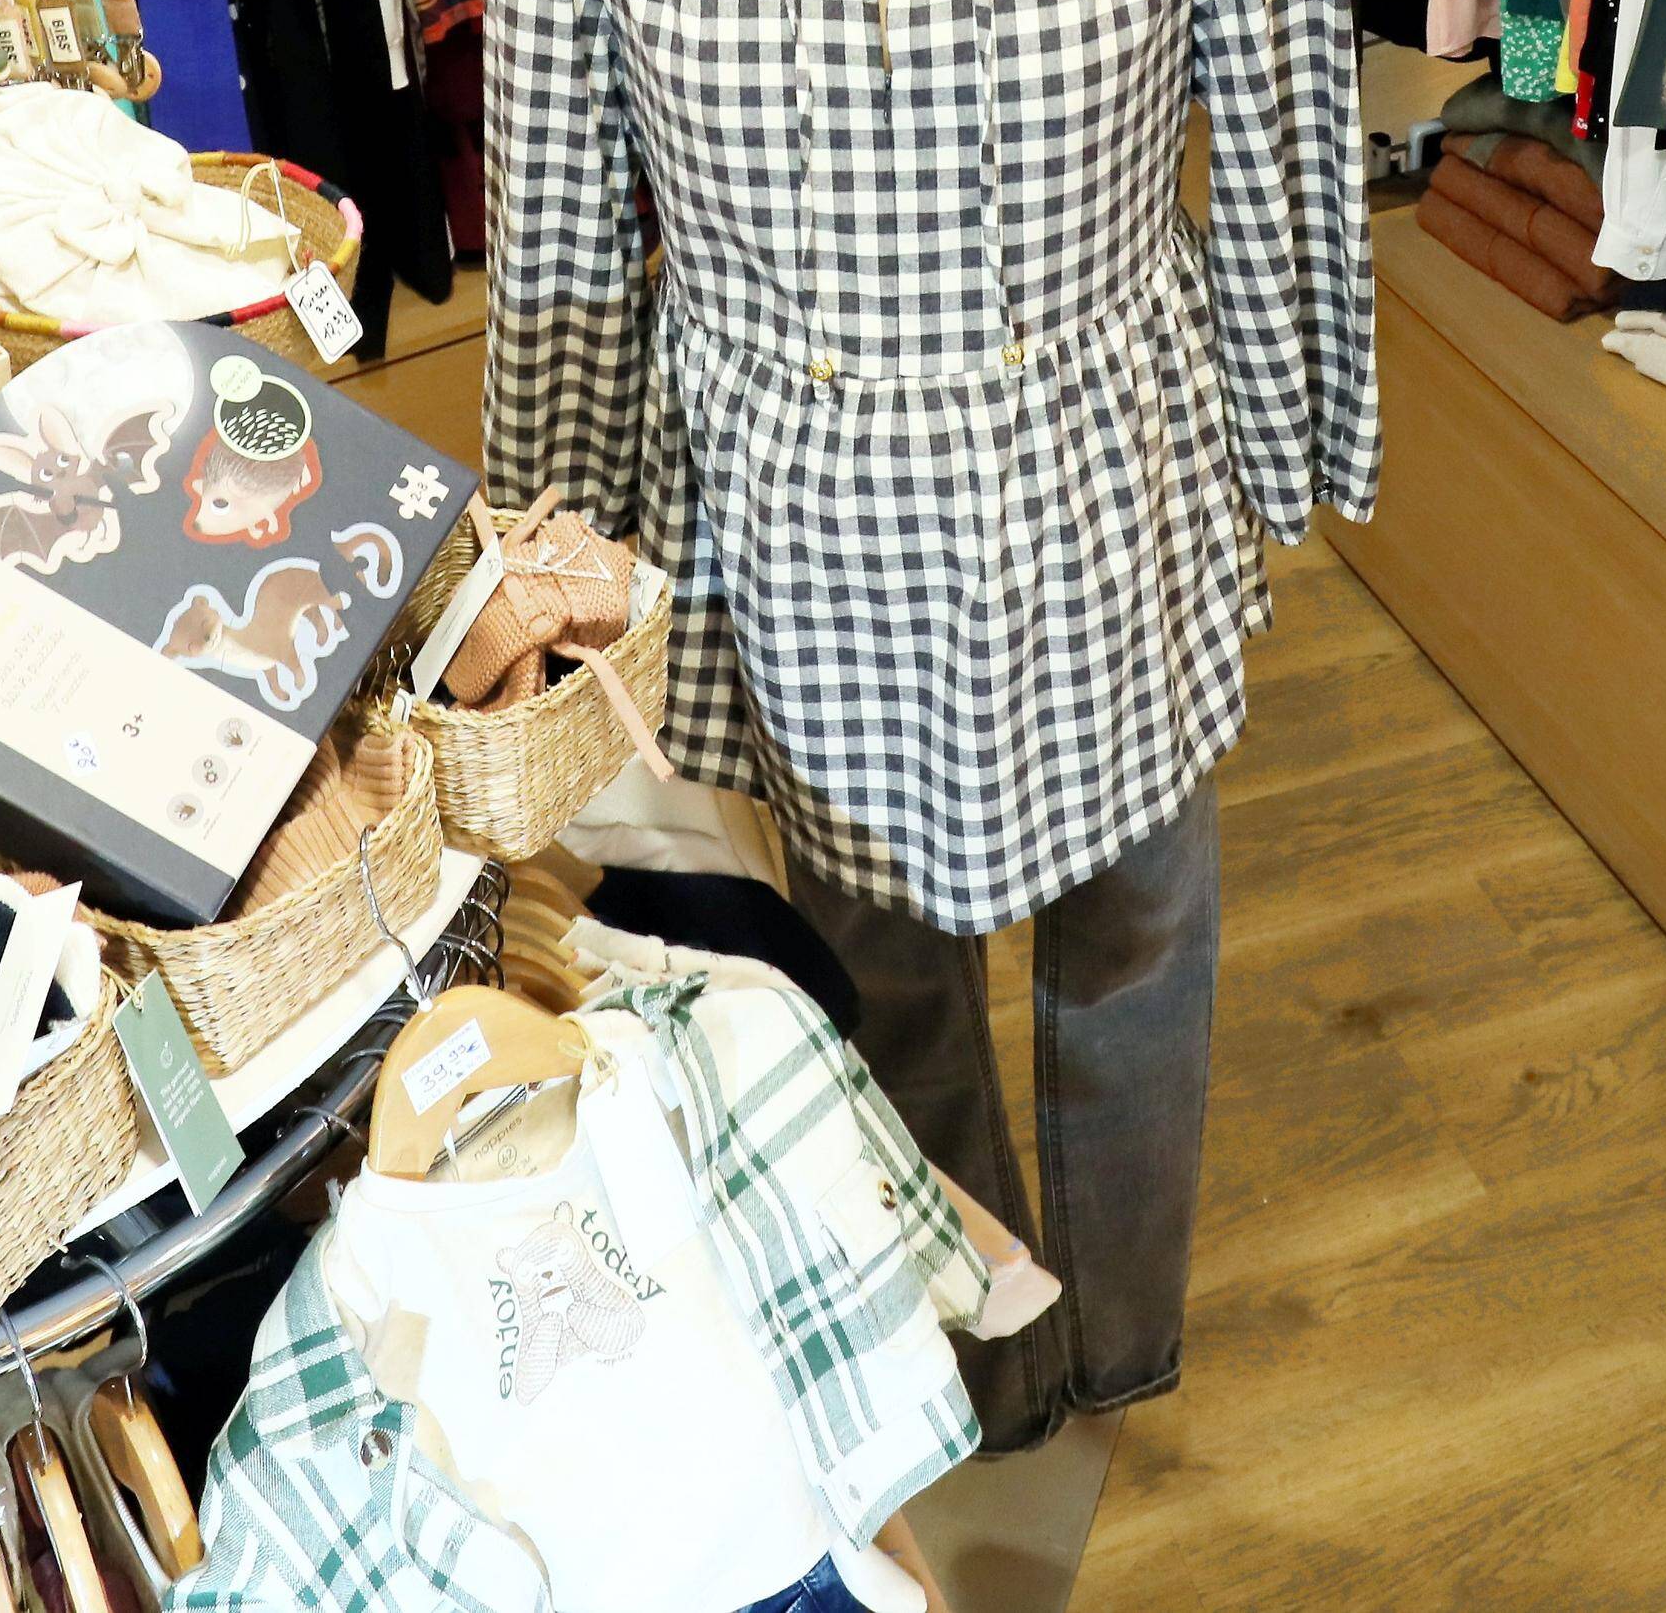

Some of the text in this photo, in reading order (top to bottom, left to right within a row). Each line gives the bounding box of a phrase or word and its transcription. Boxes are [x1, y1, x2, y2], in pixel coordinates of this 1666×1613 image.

[51, 19, 72, 51] BIBS
[121, 712, 144, 738] 3+
[473, 1116, 523, 1162] noppies
[580, 1208, 667, 1302] today
[487, 1278, 521, 1400] enjoy
